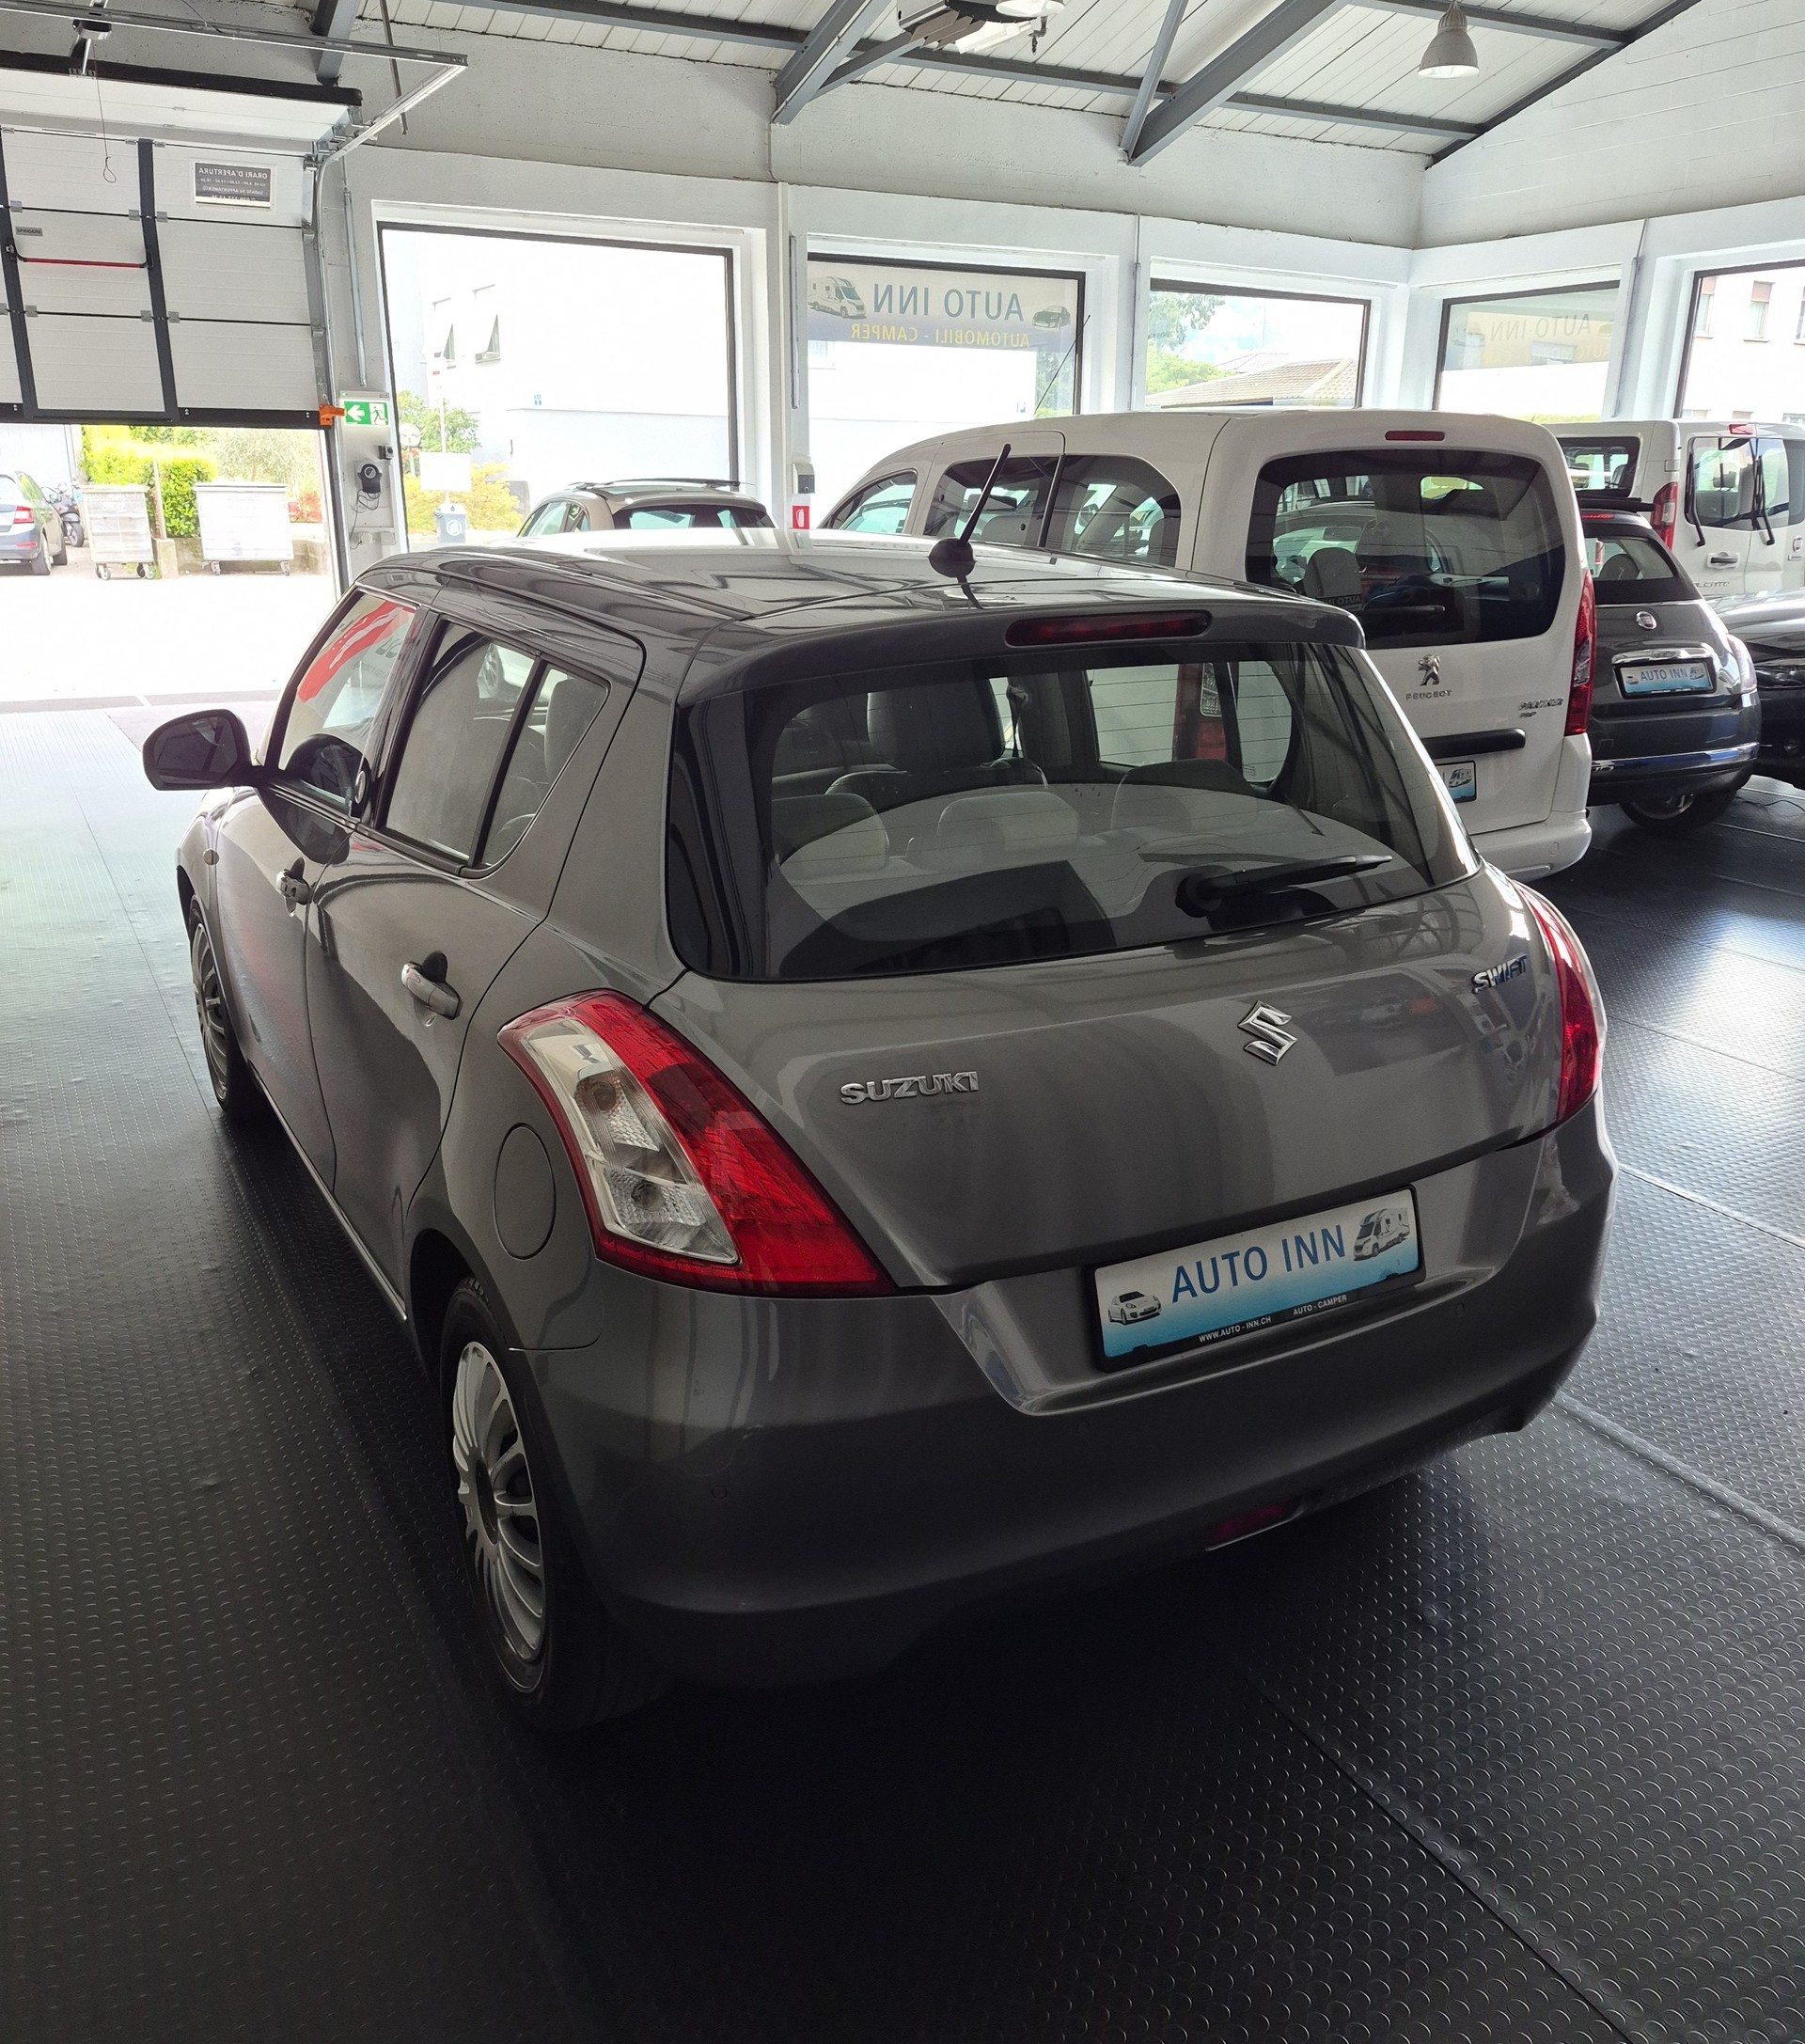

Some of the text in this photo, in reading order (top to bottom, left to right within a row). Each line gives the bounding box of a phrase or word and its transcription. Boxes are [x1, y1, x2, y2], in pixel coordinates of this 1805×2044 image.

[1640, 668, 1688, 682] AUTO INN
[1405, 689, 1452, 700] PEUGEOT
[1471, 952, 1529, 994] SWIFT
[840, 1071, 980, 1105] SUZUKI
[1171, 1224, 1346, 1304] AUTO INN
